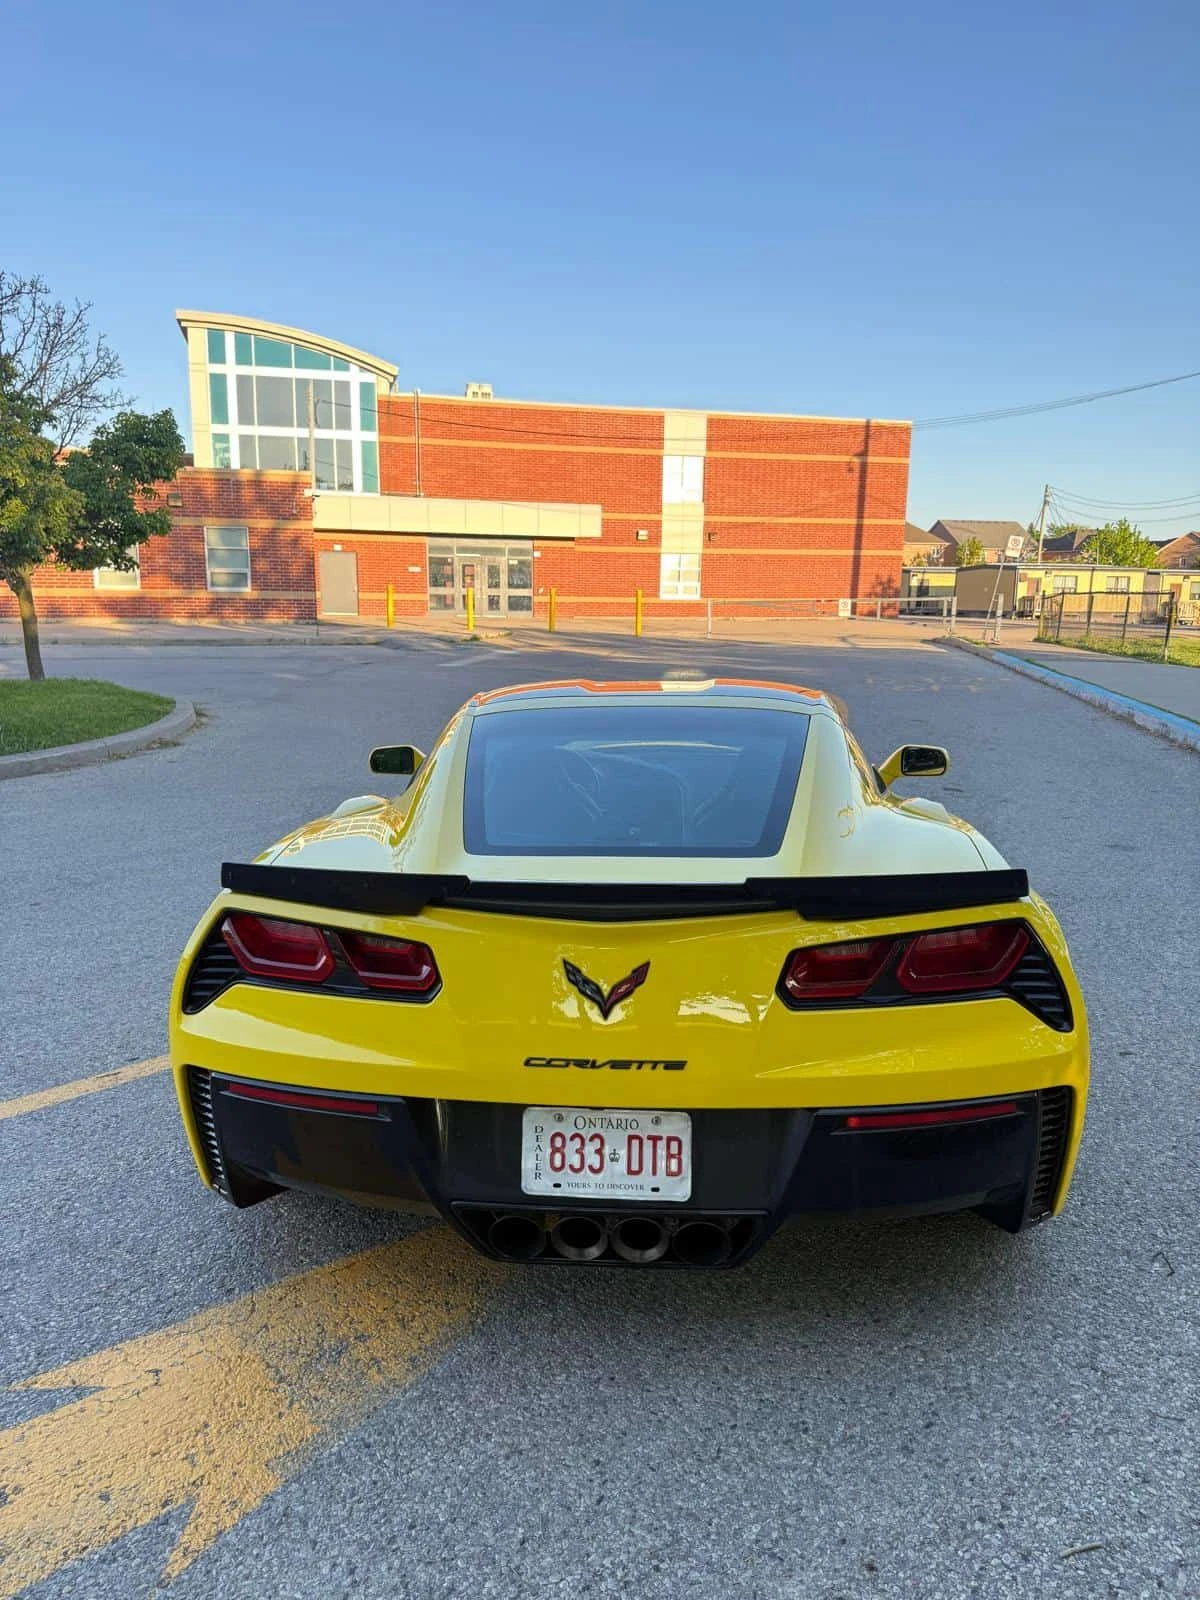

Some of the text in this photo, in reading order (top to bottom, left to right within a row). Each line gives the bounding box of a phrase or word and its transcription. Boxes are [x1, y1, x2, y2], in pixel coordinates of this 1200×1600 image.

[523, 1057, 688, 1071] CORVETTE
[574, 1116, 640, 1131] ONTARIO
[534, 1125, 544, 1180] DEALER
[549, 1132, 683, 1177] 833 DTB
[567, 1181, 591, 1189] YOURS
[606, 1183, 645, 1191] DISCOVER
